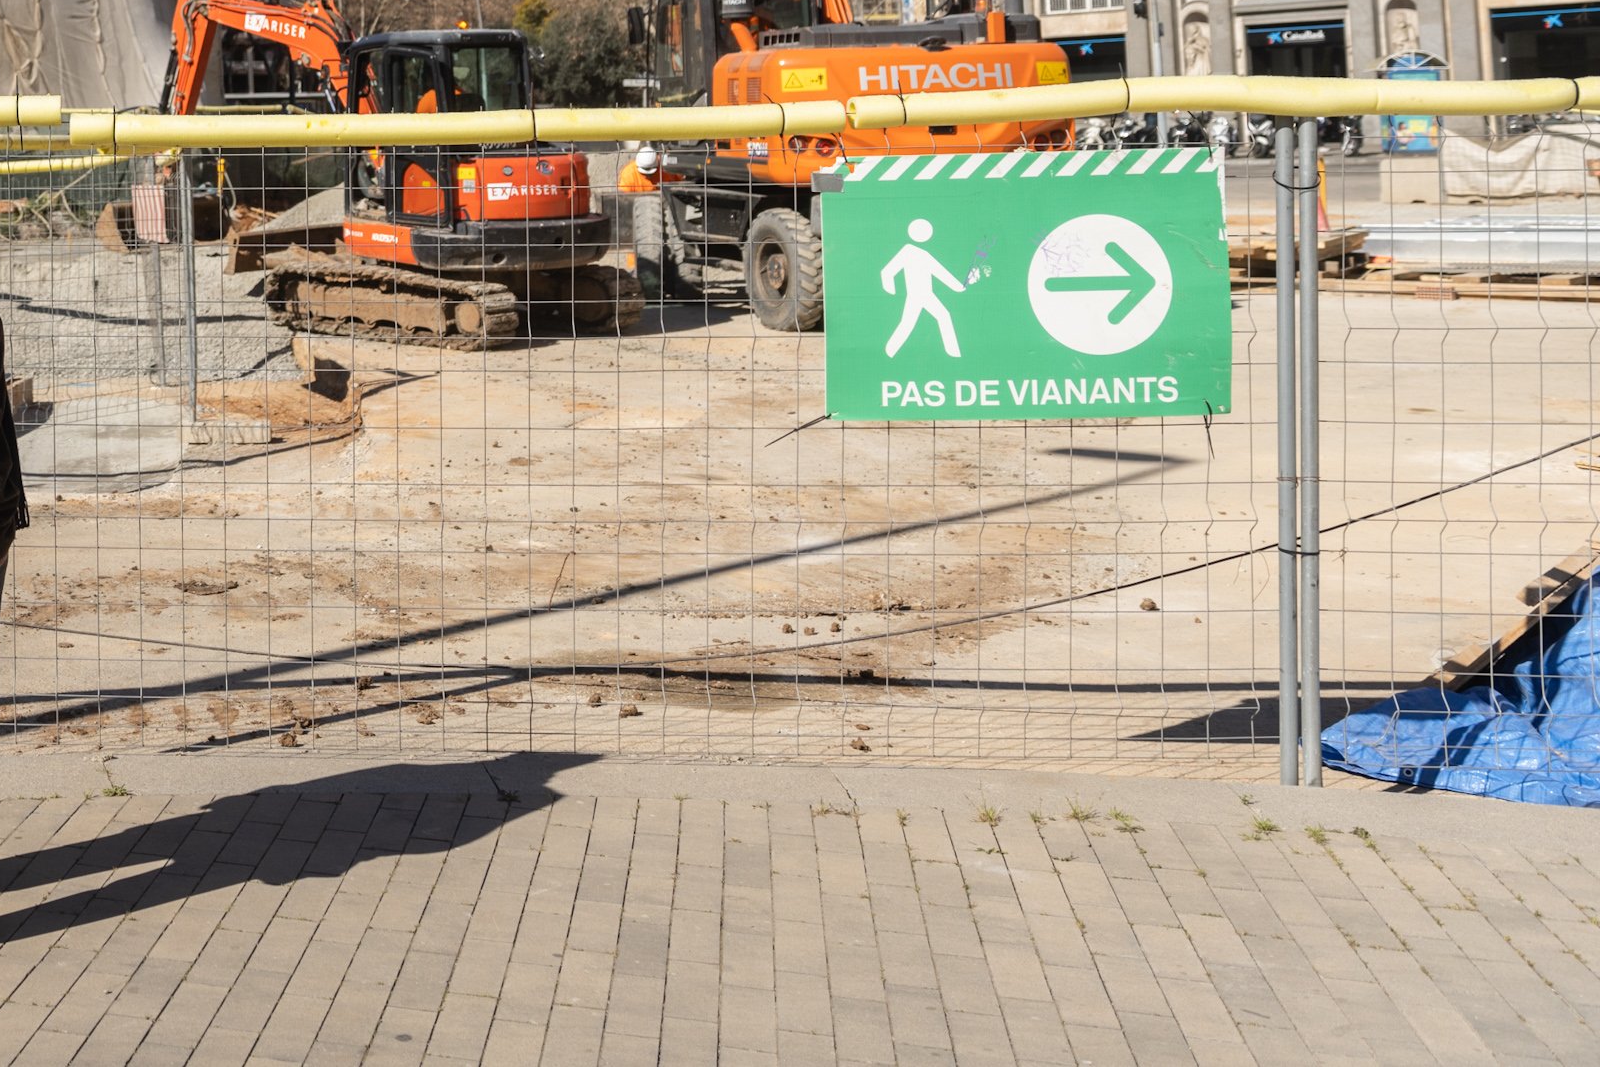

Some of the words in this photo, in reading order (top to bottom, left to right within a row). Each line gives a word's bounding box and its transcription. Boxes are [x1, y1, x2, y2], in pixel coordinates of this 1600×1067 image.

[244, 11, 306, 39] EXARISER
[858, 62, 1014, 91] HITACHI
[487, 183, 558, 201] EXARISER
[881, 380, 946, 407] PAS
[955, 379, 1000, 406] DE
[1007, 376, 1179, 406] VIANANTS
